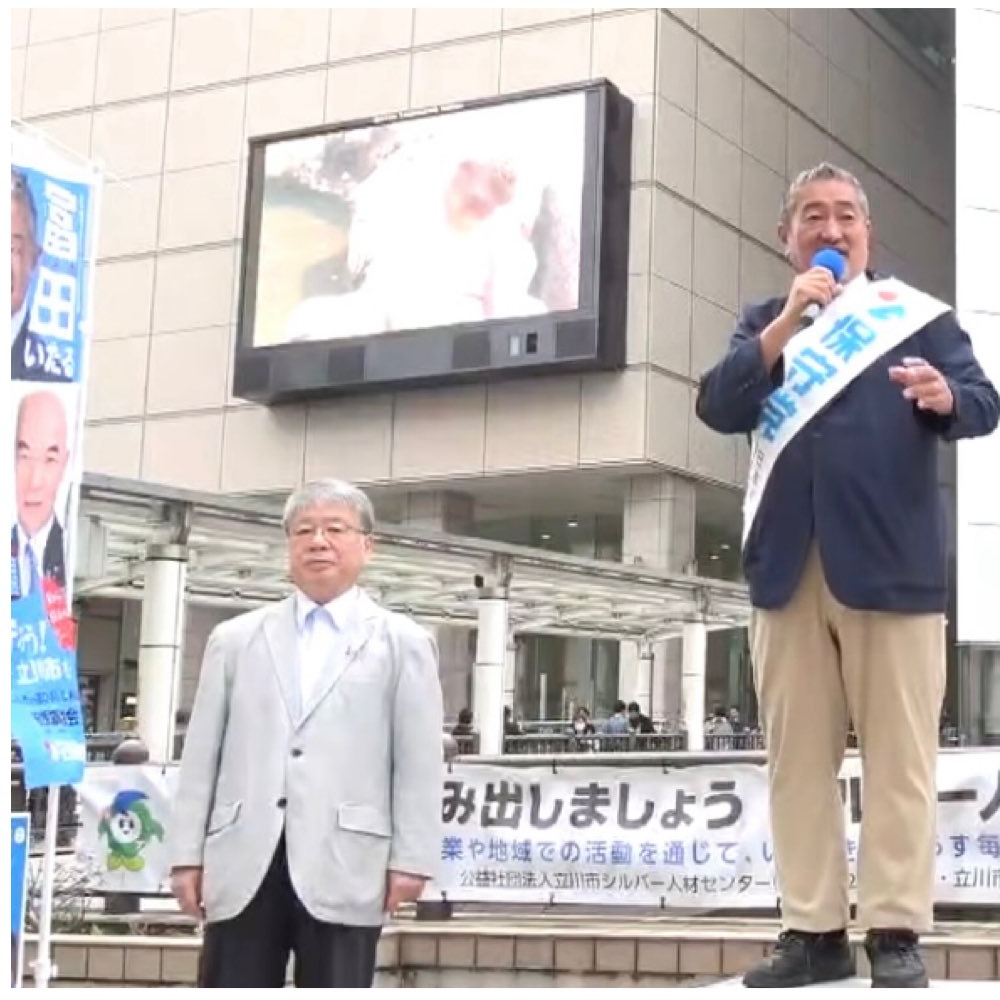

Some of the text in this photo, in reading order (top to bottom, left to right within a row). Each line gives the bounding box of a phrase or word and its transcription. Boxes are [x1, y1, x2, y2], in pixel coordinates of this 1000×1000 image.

[759, 314, 877, 442] 保守党
[441, 780, 743, 830] み出しましょう
